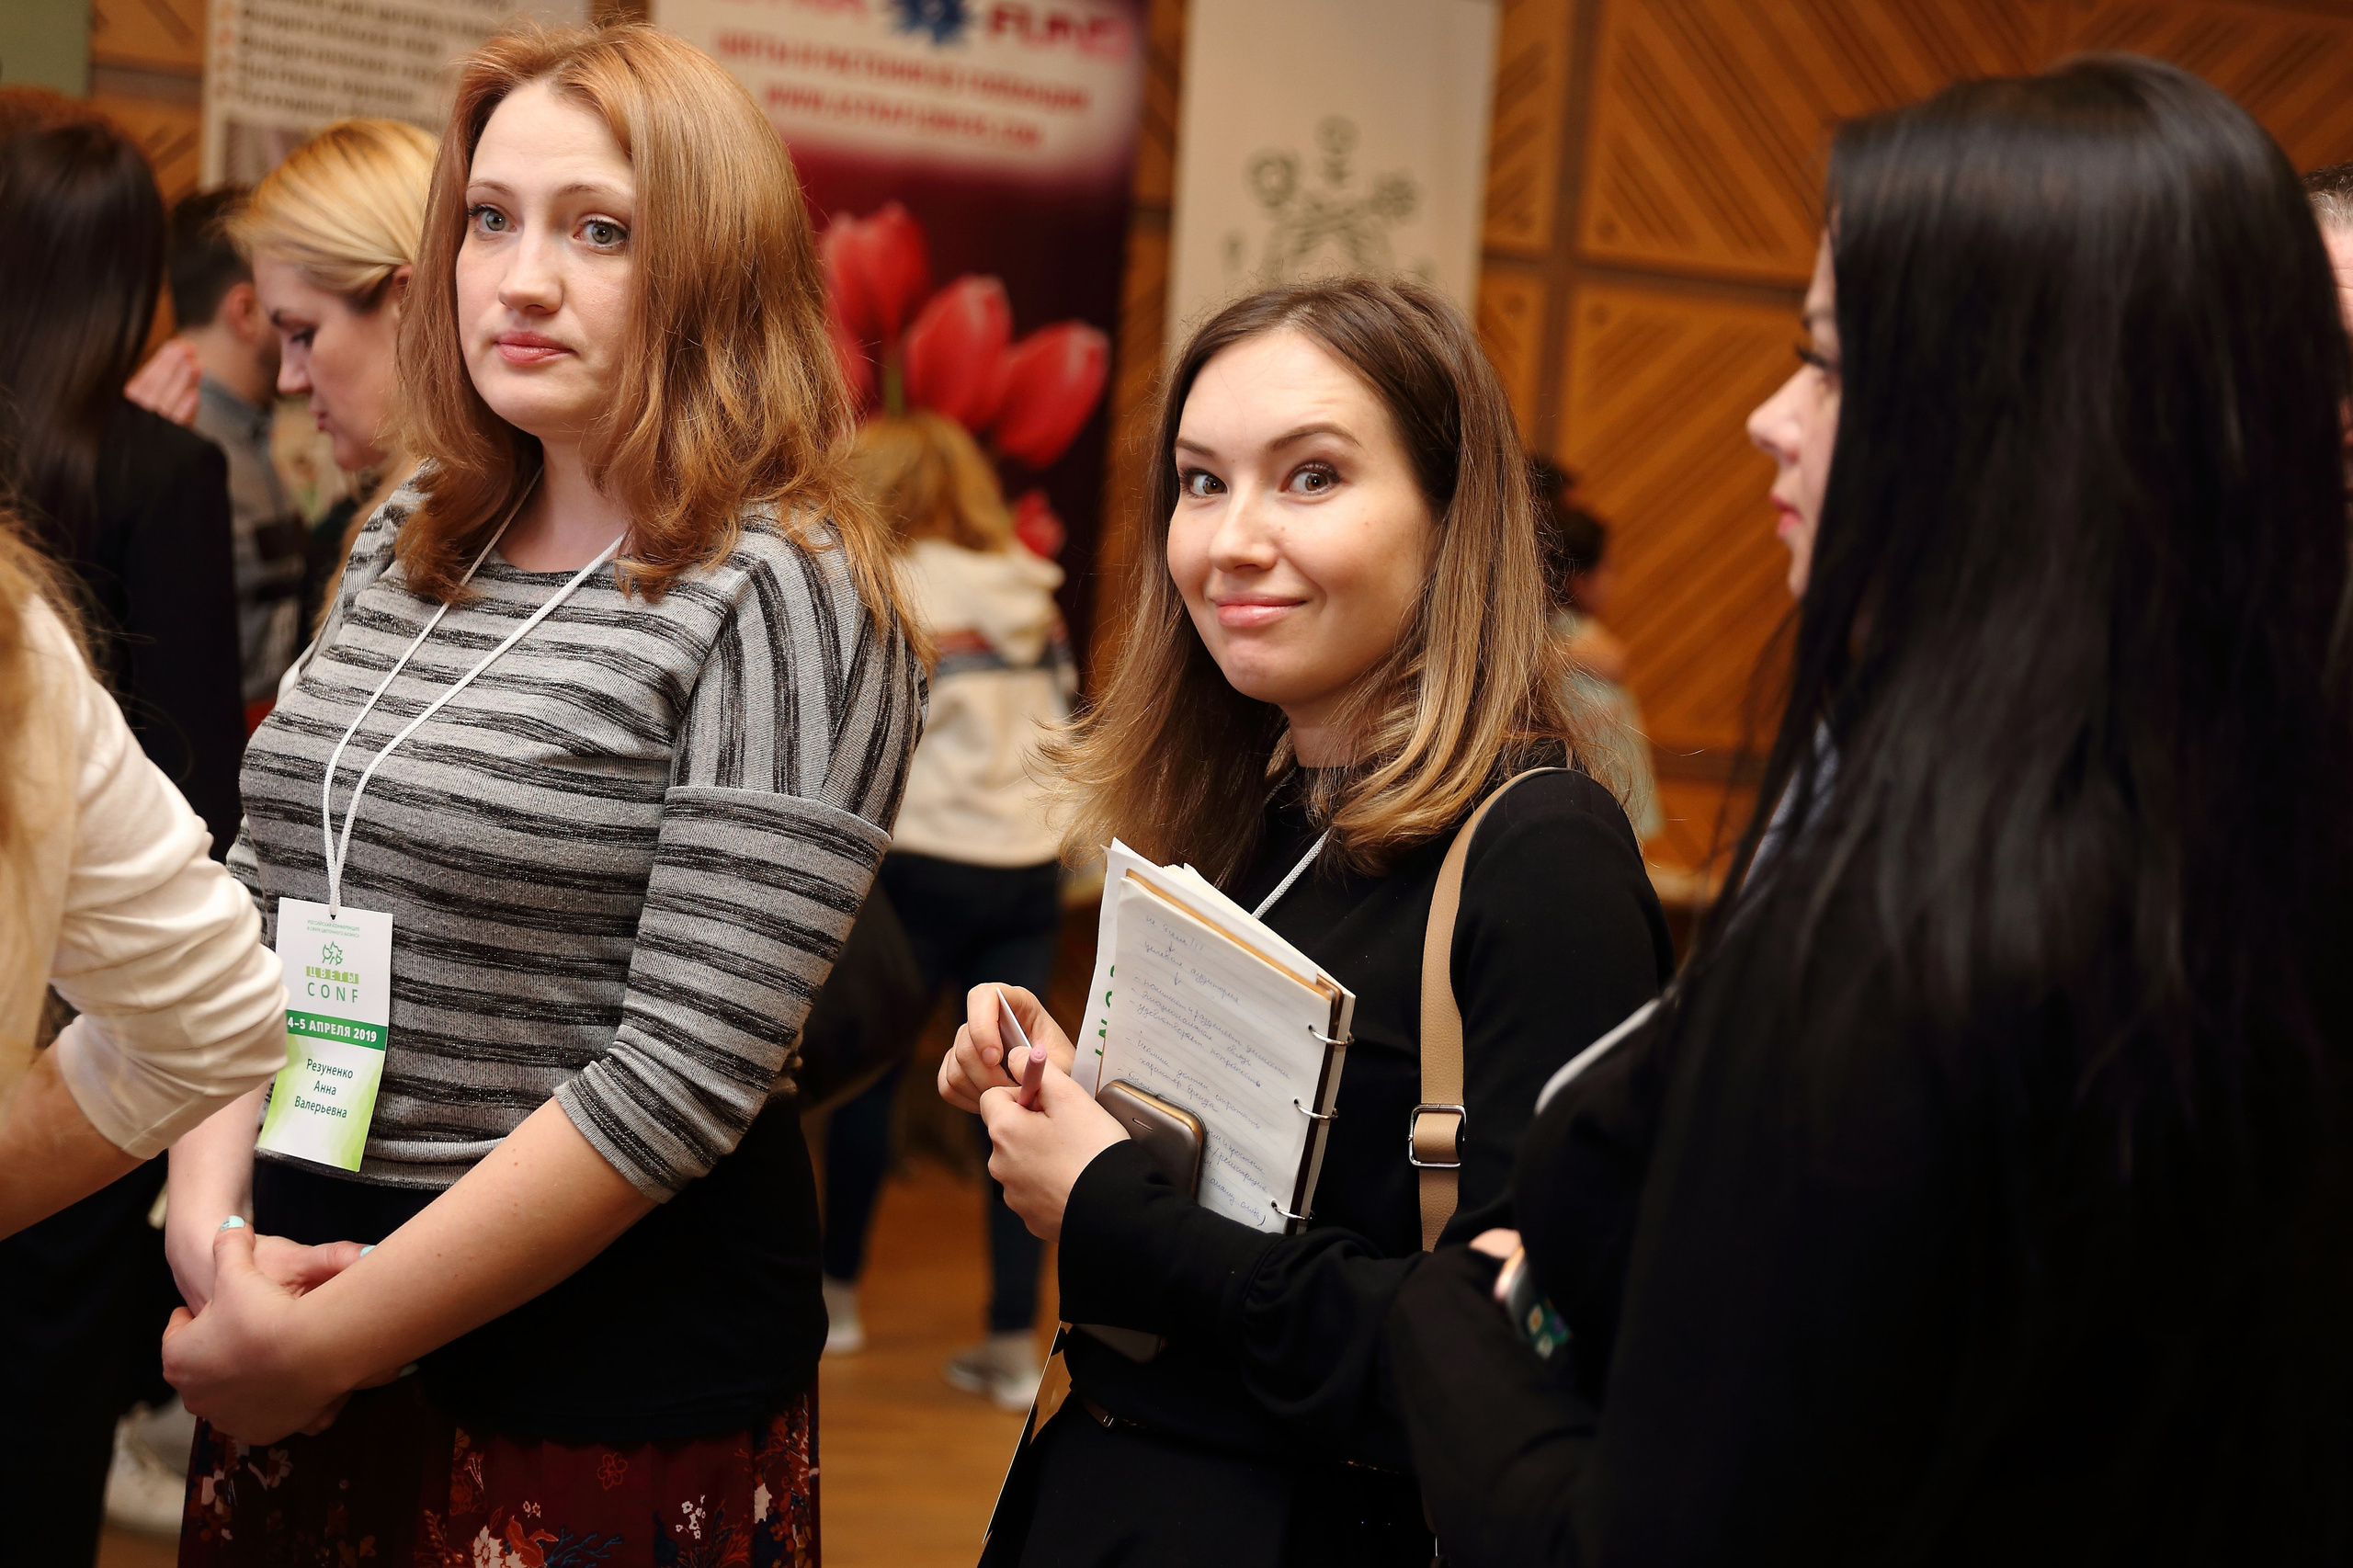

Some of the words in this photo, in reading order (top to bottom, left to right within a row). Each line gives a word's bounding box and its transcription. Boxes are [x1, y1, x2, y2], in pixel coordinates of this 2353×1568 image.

[309, 966, 357, 983] ЦВЕТЫ
[307, 982, 358, 1003] CONF
[309, 1019, 351, 1038] АПРЕЛЯ
[353, 1028, 378, 1043] 2019
[306, 1058, 354, 1079] Резуненко
[313, 1080, 337, 1096] Анна
[294, 1096, 347, 1119] Валерьевна
